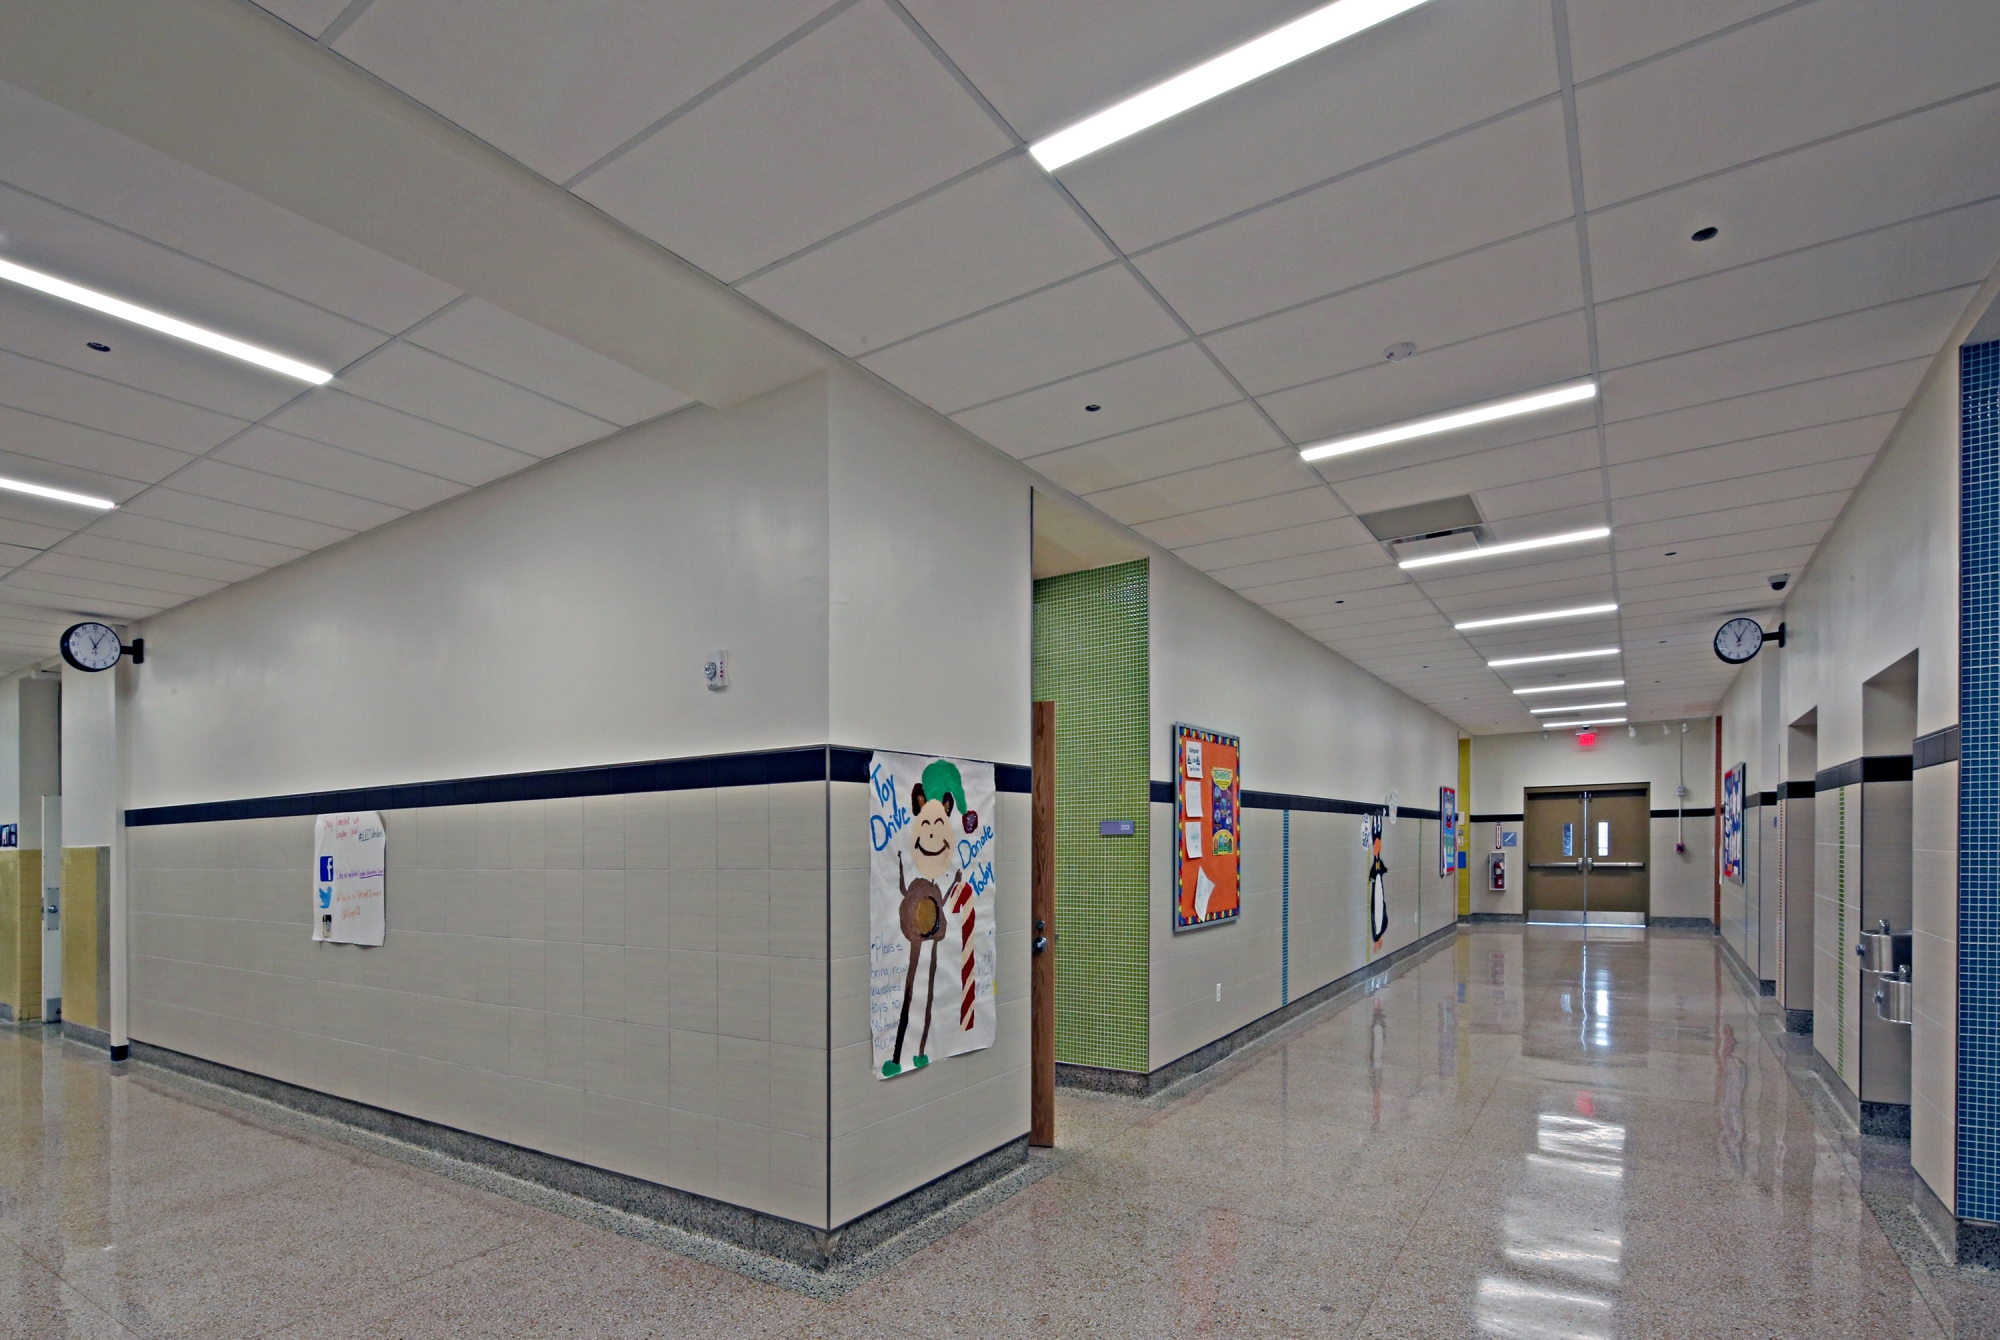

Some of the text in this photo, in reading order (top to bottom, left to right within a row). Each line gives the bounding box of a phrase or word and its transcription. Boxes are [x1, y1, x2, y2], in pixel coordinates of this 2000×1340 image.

[870, 763, 898, 817] Toy
[870, 806, 910, 851] Drive
[958, 826, 993, 869] Donate
[968, 862, 995, 896] Today
[875, 933, 903, 962] Please
[892, 964, 907, 974] new
[891, 998, 901, 1009] to
